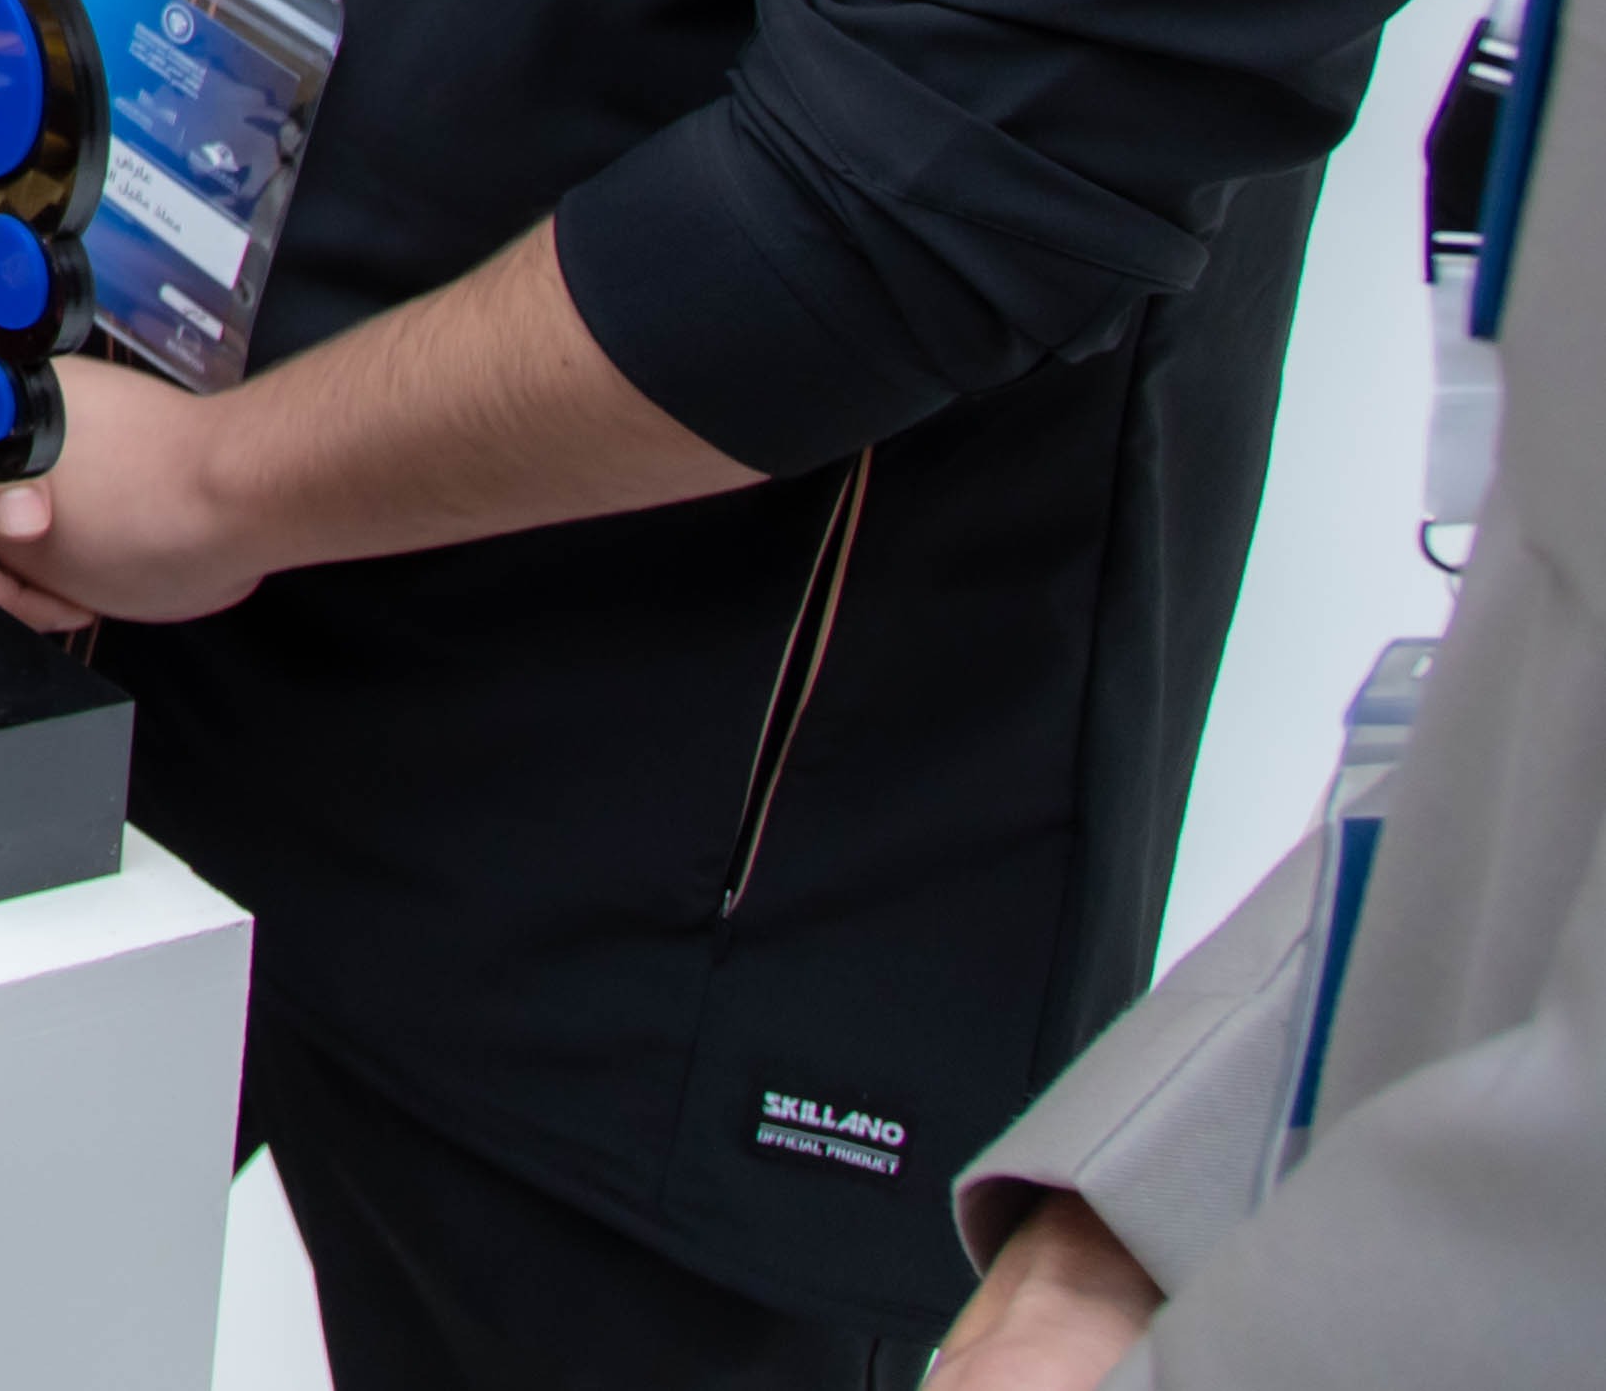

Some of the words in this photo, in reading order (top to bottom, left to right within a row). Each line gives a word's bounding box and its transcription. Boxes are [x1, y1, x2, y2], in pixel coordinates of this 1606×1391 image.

[762, 1090, 906, 1147] SKILLANO
[756, 1127, 823, 1156] OFFICIAL
[825, 1144, 901, 1176] PRODUCT
